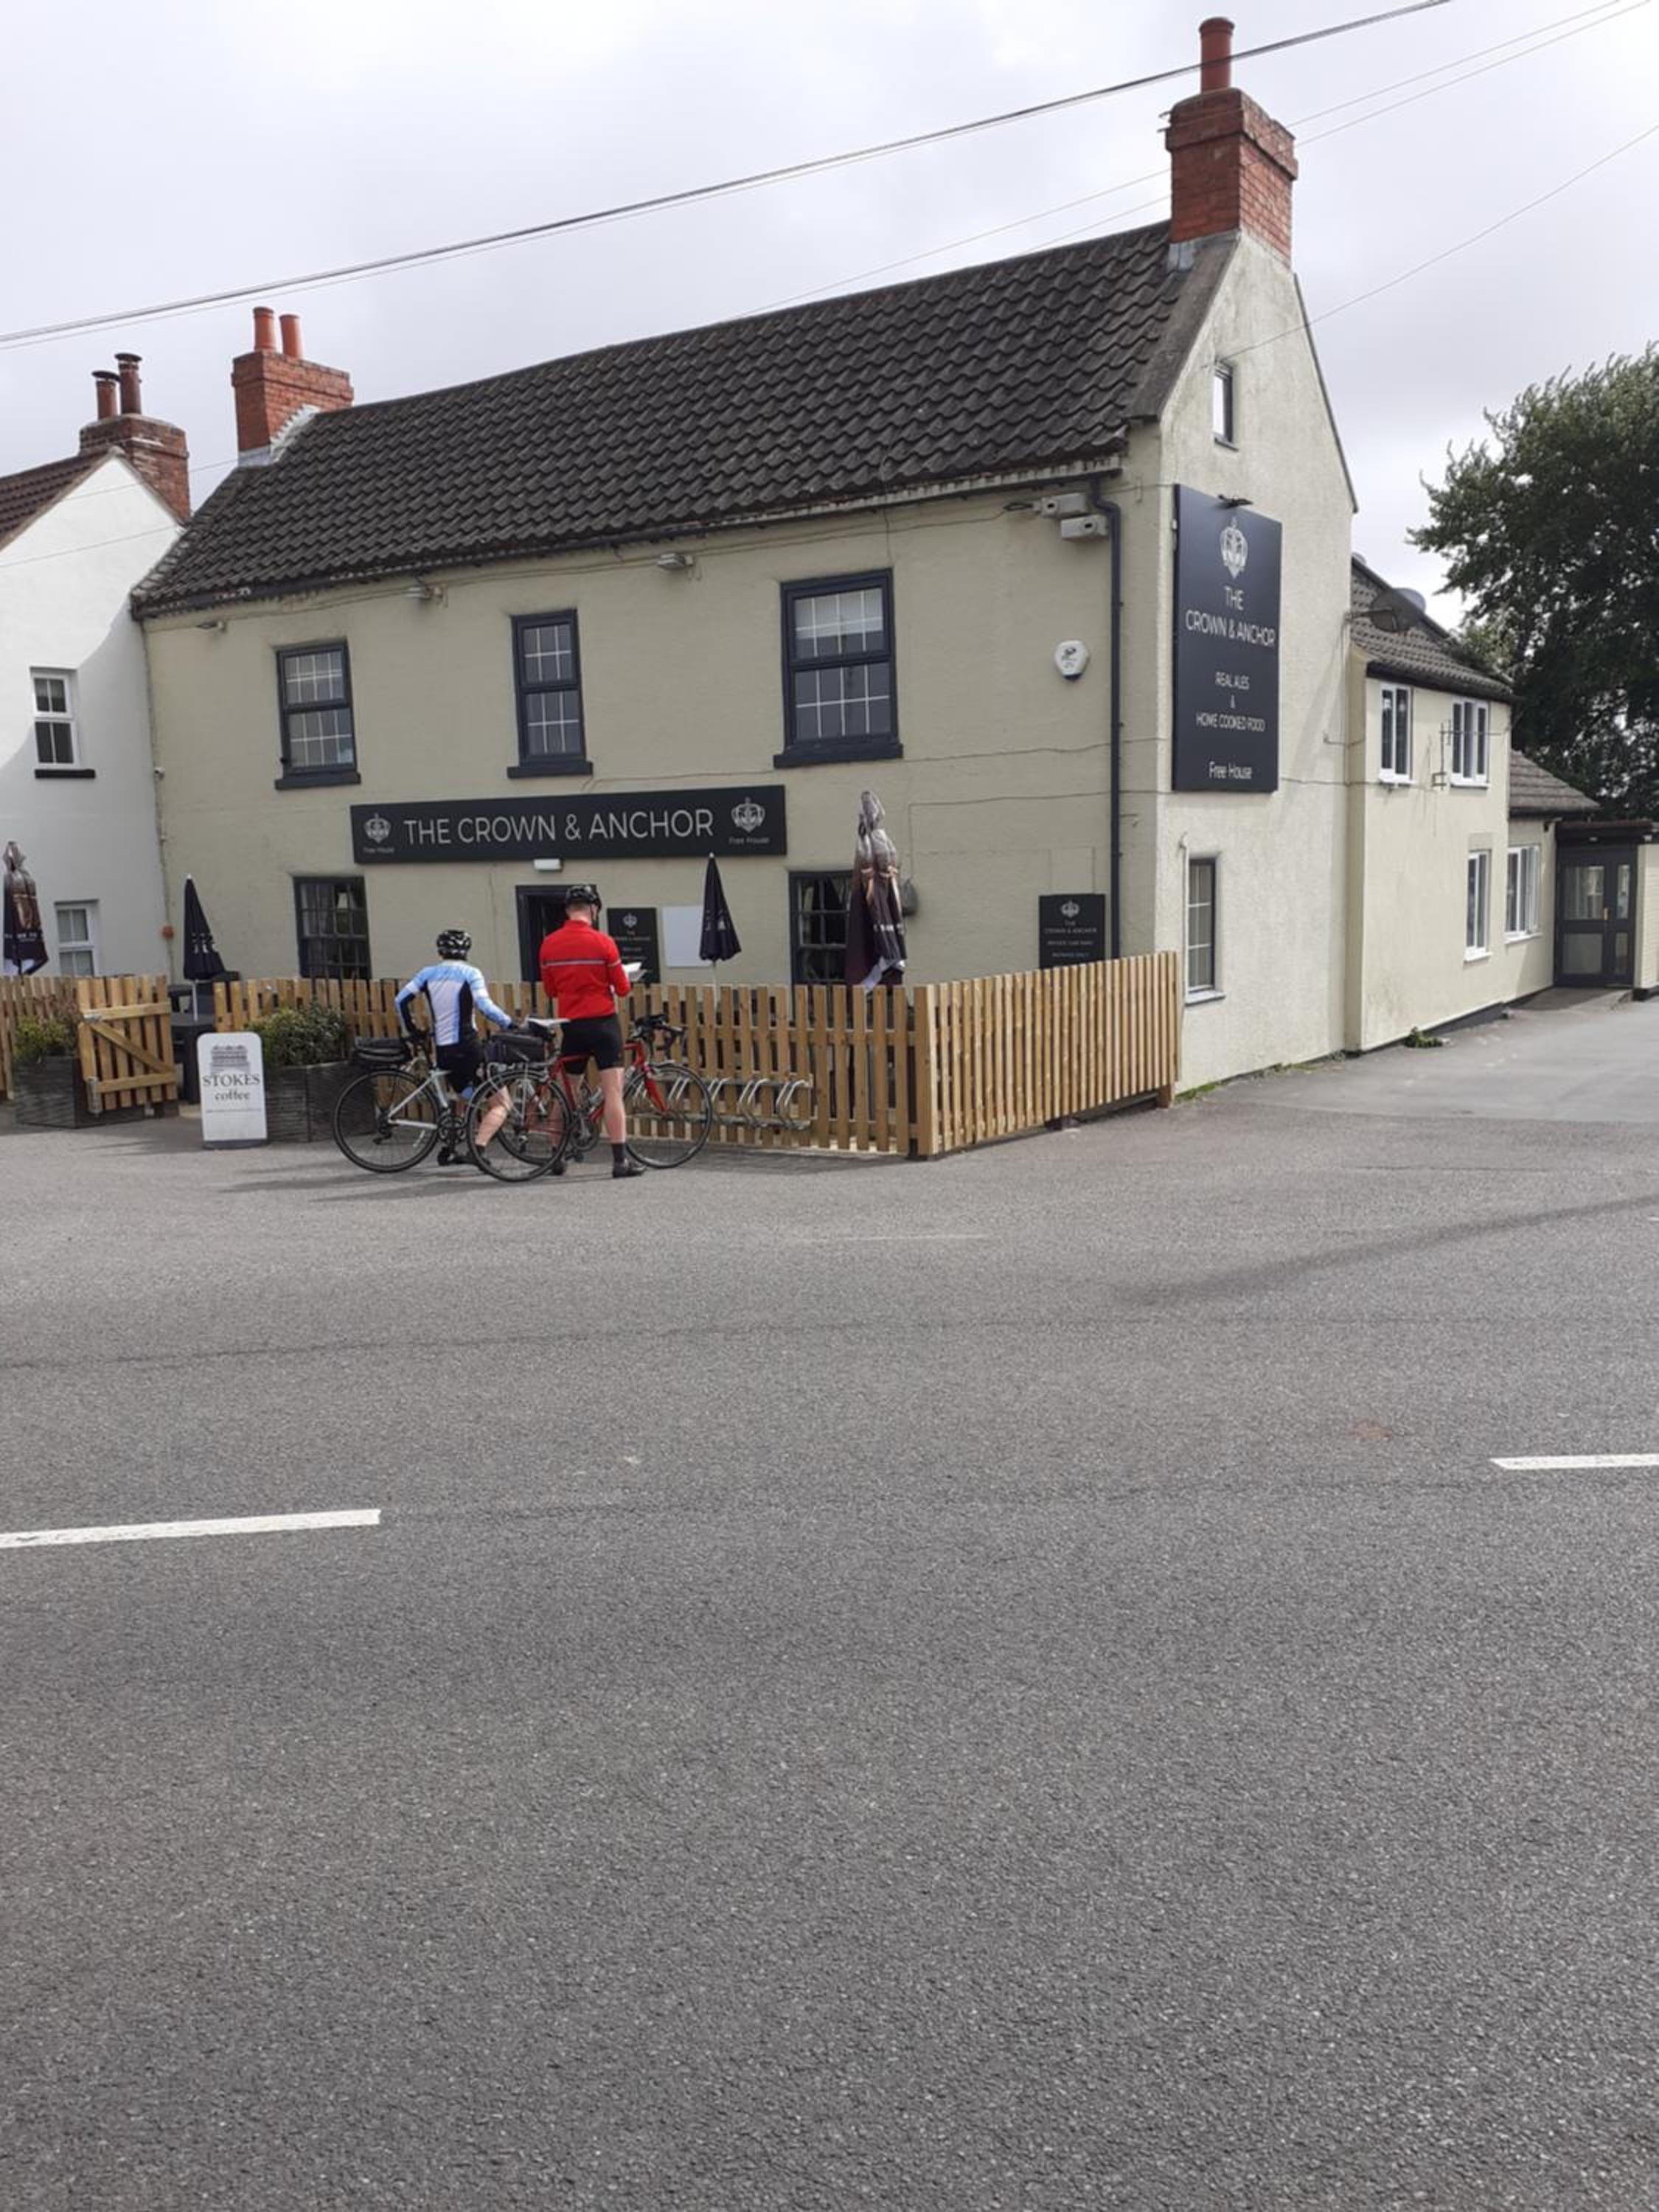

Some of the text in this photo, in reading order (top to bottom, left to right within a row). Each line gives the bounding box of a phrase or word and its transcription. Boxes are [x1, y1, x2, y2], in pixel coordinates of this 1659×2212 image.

[1224, 585, 1244, 611] THE
[1186, 610, 1276, 647] CROWN & ANCHOR
[1215, 672, 1250, 690] REAL ALES
[1196, 712, 1217, 728] HOME
[1248, 717, 1266, 732] FOOD
[1209, 761, 1252, 779] Free House
[403, 809, 714, 844] THE CROWN & ANCHOR
[202, 1073, 260, 1088] STOKES
[214, 1089, 251, 1102] coffee
